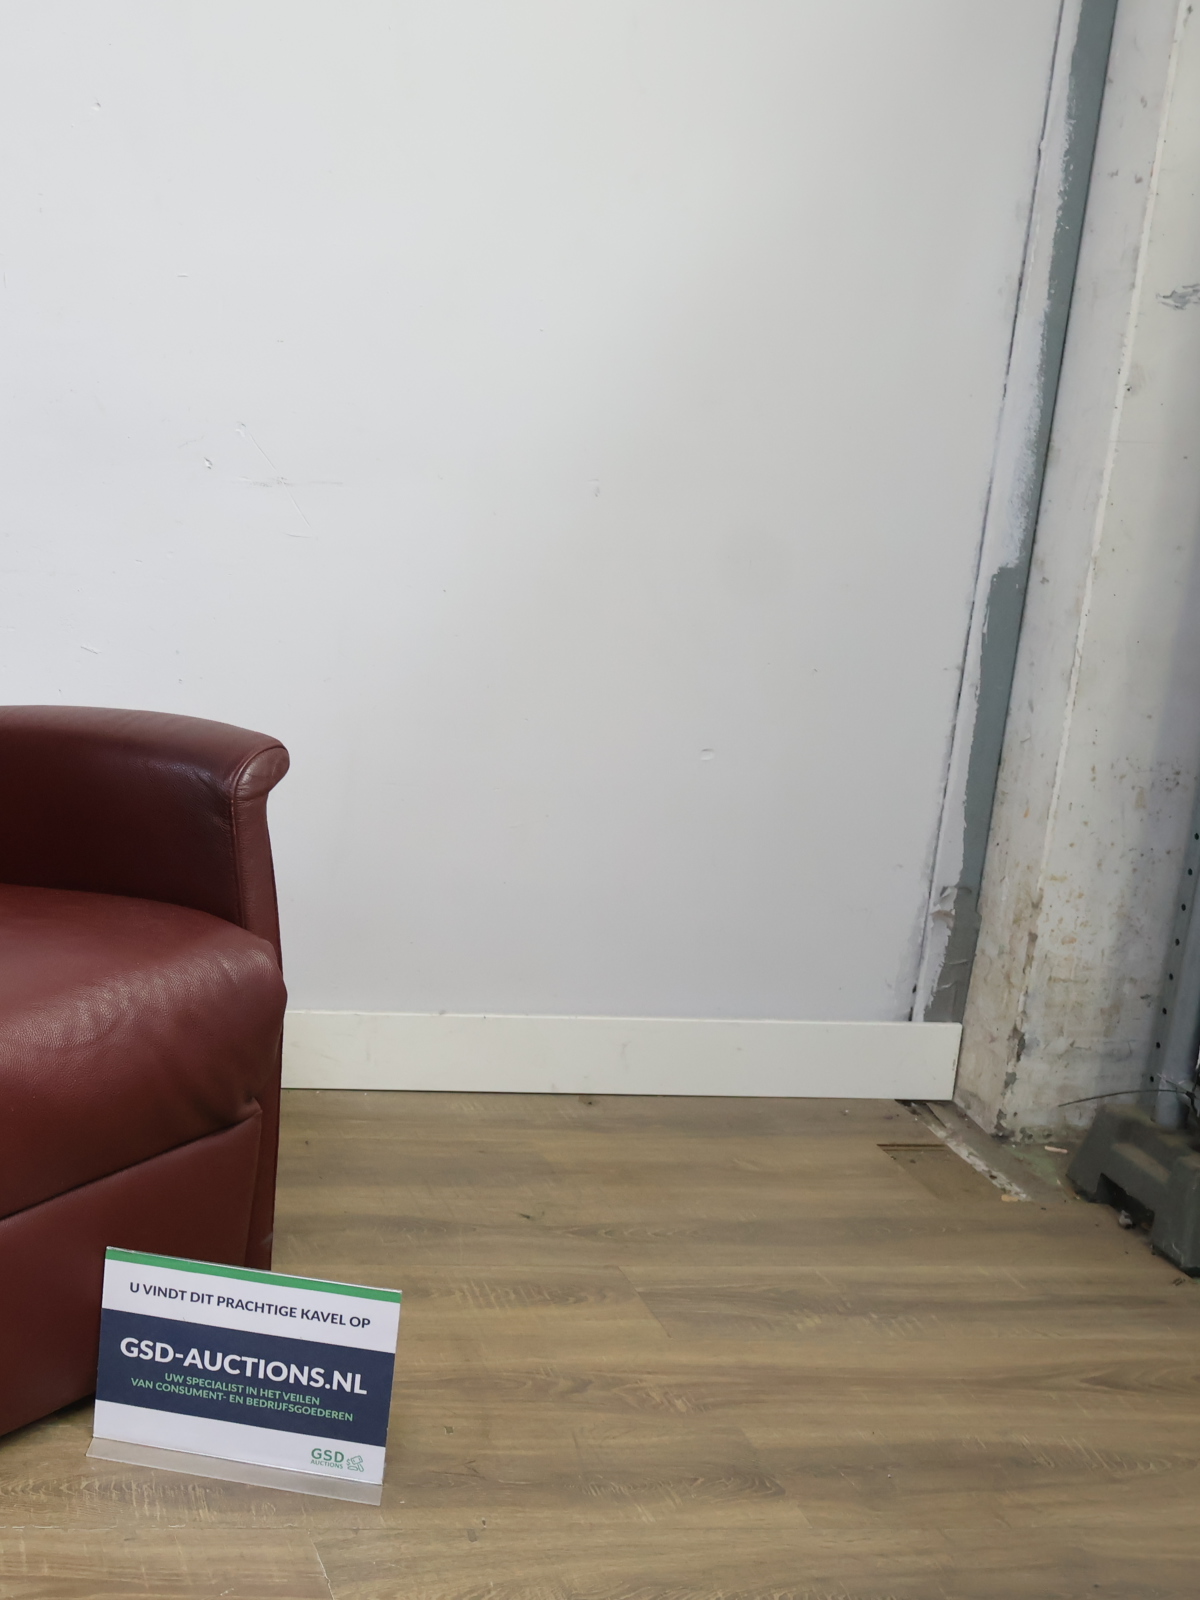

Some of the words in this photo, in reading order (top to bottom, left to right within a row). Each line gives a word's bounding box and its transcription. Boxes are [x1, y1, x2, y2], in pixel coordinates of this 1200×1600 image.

[129, 1281, 140, 1293] U
[143, 1284, 187, 1301] VINDT
[190, 1291, 214, 1305] DIT
[217, 1296, 297, 1318] PRACHTIGE
[301, 1308, 346, 1326] KAVEL
[349, 1316, 371, 1329] OP
[120, 1337, 367, 1395] GSD-AUCTIONS.NL
[131, 1377, 154, 1389] VAN
[155, 1381, 227, 1401] CONSUMENT-
[229, 1393, 243, 1403] EN
[246, 1396, 353, 1421] BEDRIJFSGOEDEREN
[164, 1372, 185, 1384] UW
[186, 1376, 243, 1392] SPECIALIST
[246, 1385, 258, 1395] IN
[260, 1387, 281, 1399] HET
[283, 1391, 320, 1405] VEILEN
[310, 1459, 343, 1469] AUCTIONS
[311, 1448, 344, 1462] GSD
